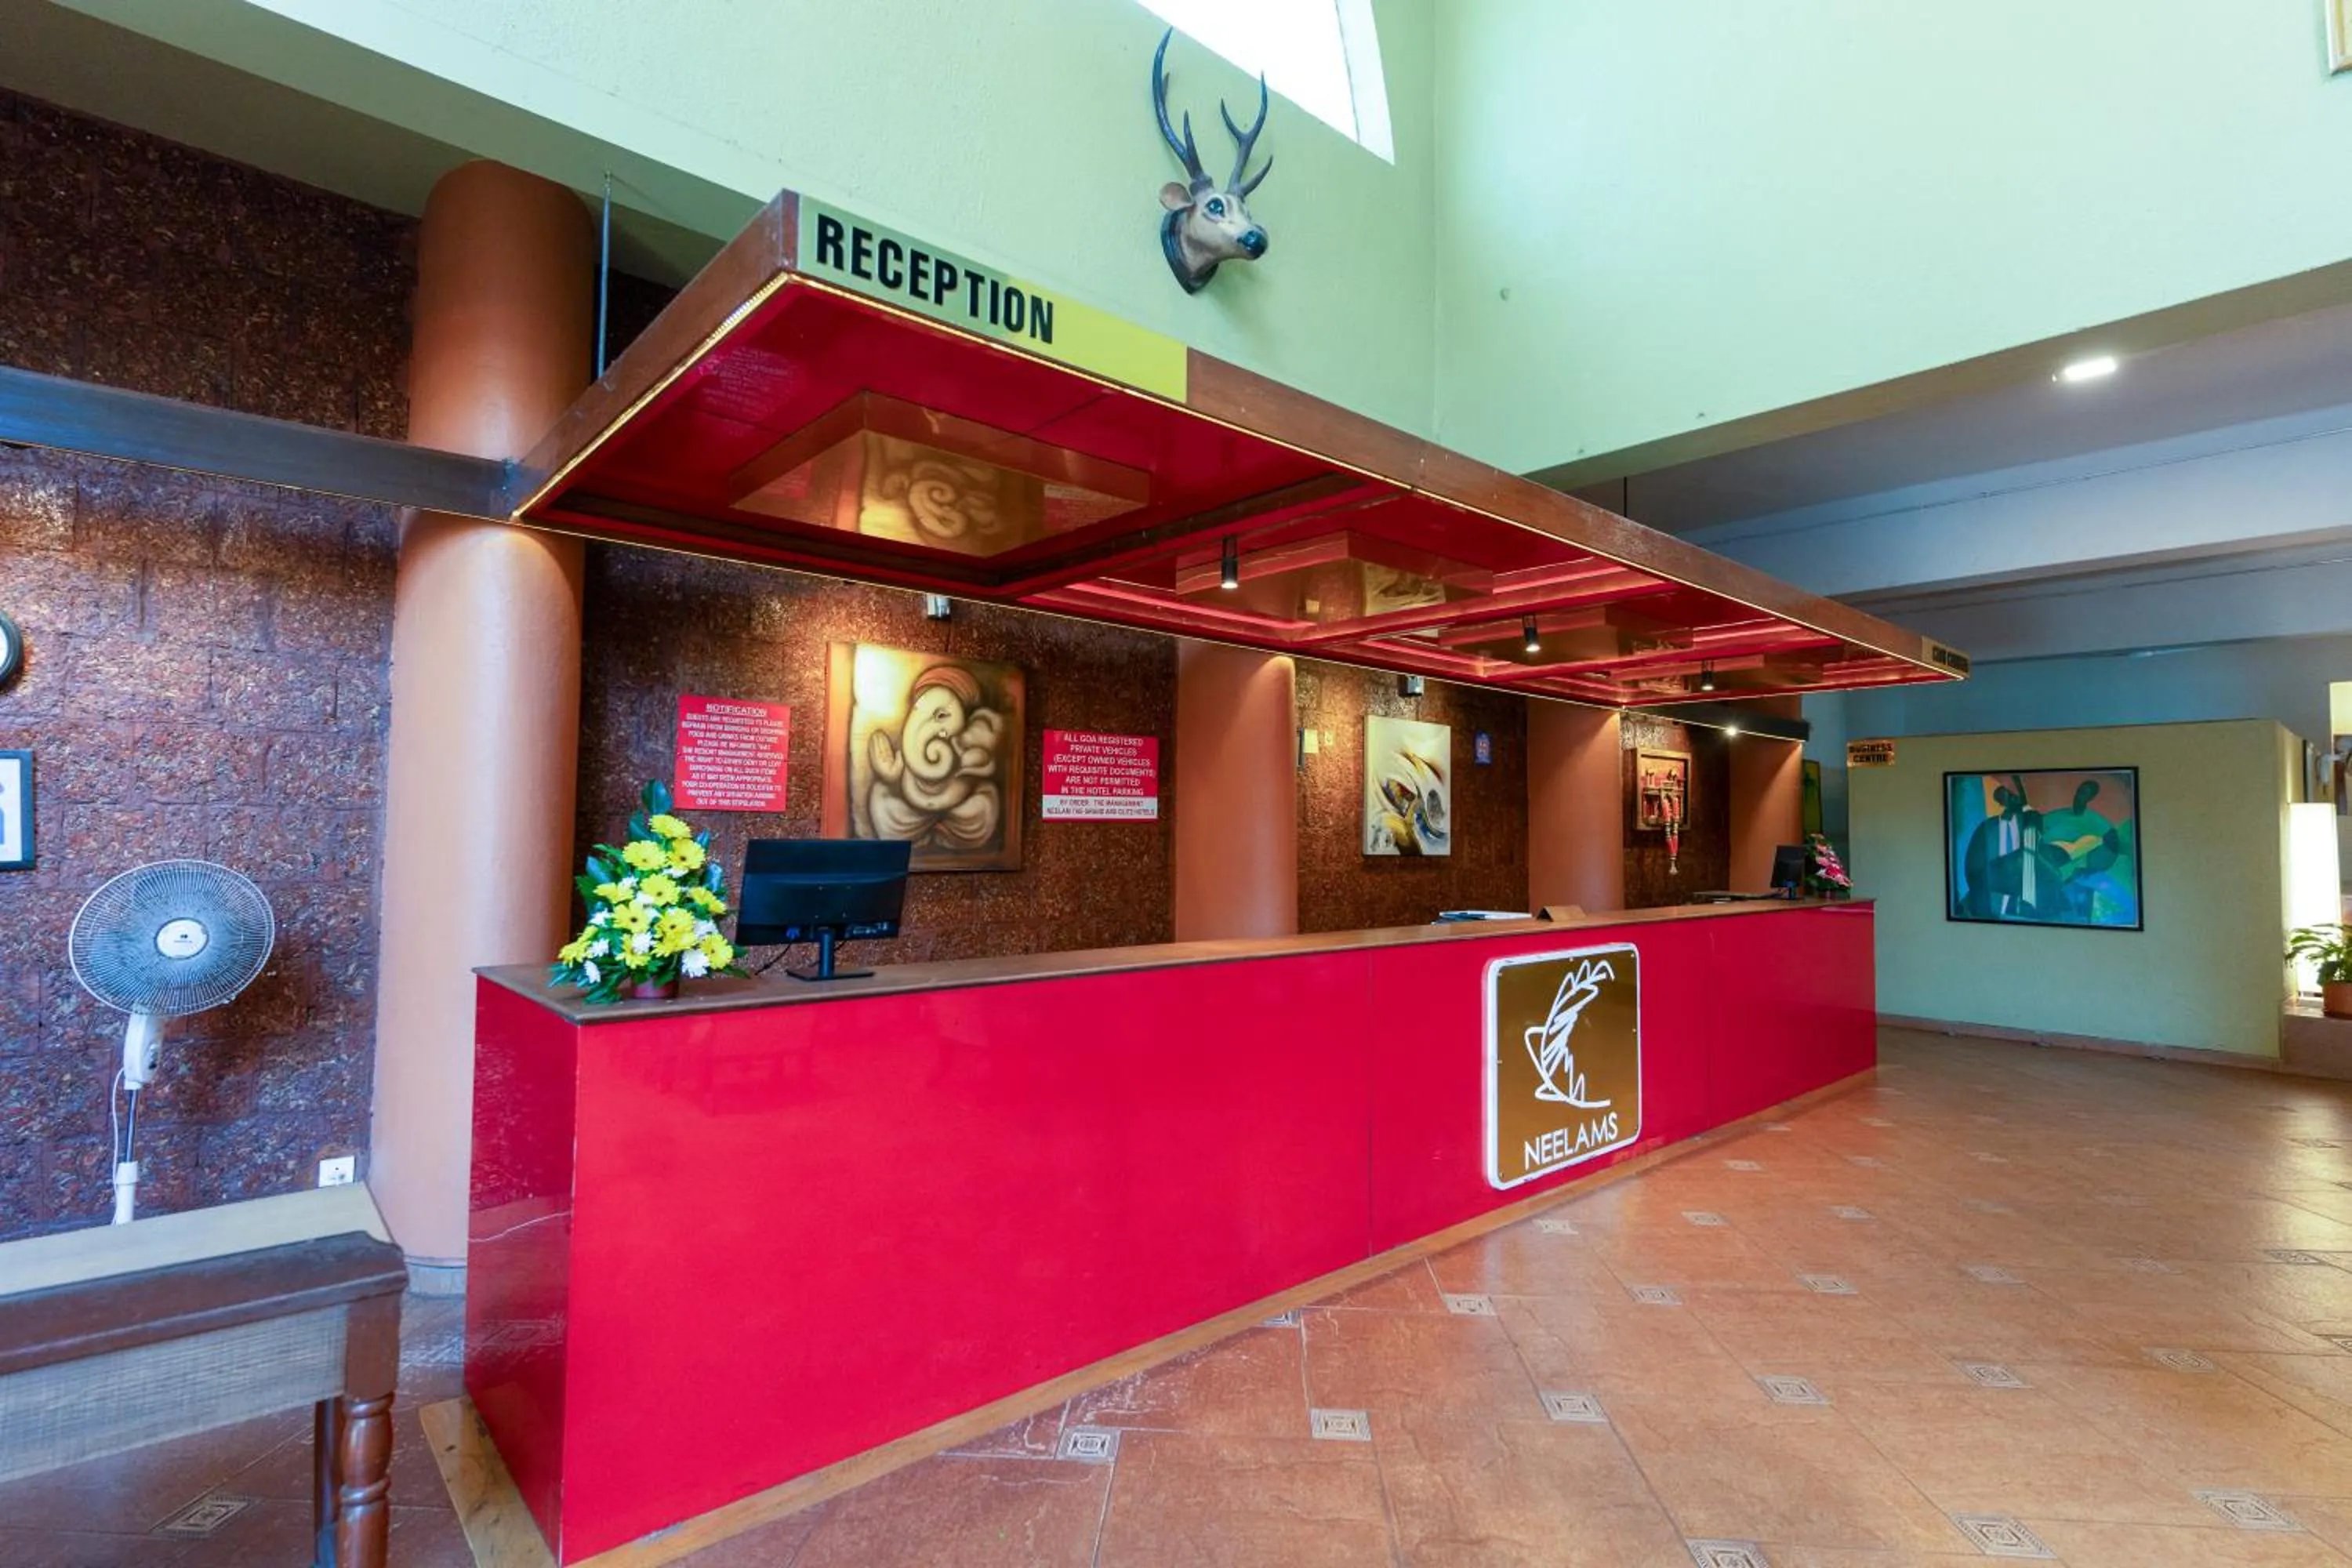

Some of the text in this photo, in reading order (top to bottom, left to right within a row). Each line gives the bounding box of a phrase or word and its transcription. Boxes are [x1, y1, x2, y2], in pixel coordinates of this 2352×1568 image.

[816, 212, 1054, 344] RECEPTION
[1063, 733, 1143, 746] ALL GOA REGISTERED
[1069, 744, 1137, 757] PRIVATE VEHICLES
[1849, 743, 1893, 753] BUSINESS
[1087, 756, 1115, 765] OWNED
[1116, 757, 1151, 767] VEHICLES
[1853, 753, 1889, 763] CENTRE
[1047, 764, 1067, 773] WITH
[1069, 765, 1107, 775] REQUISITE
[1065, 775, 1081, 784] ARE
[1100, 777, 1141, 786] PERMITTED
[1112, 787, 1144, 796] PARKING
[1524, 1111, 1619, 1171] NEELAMS
